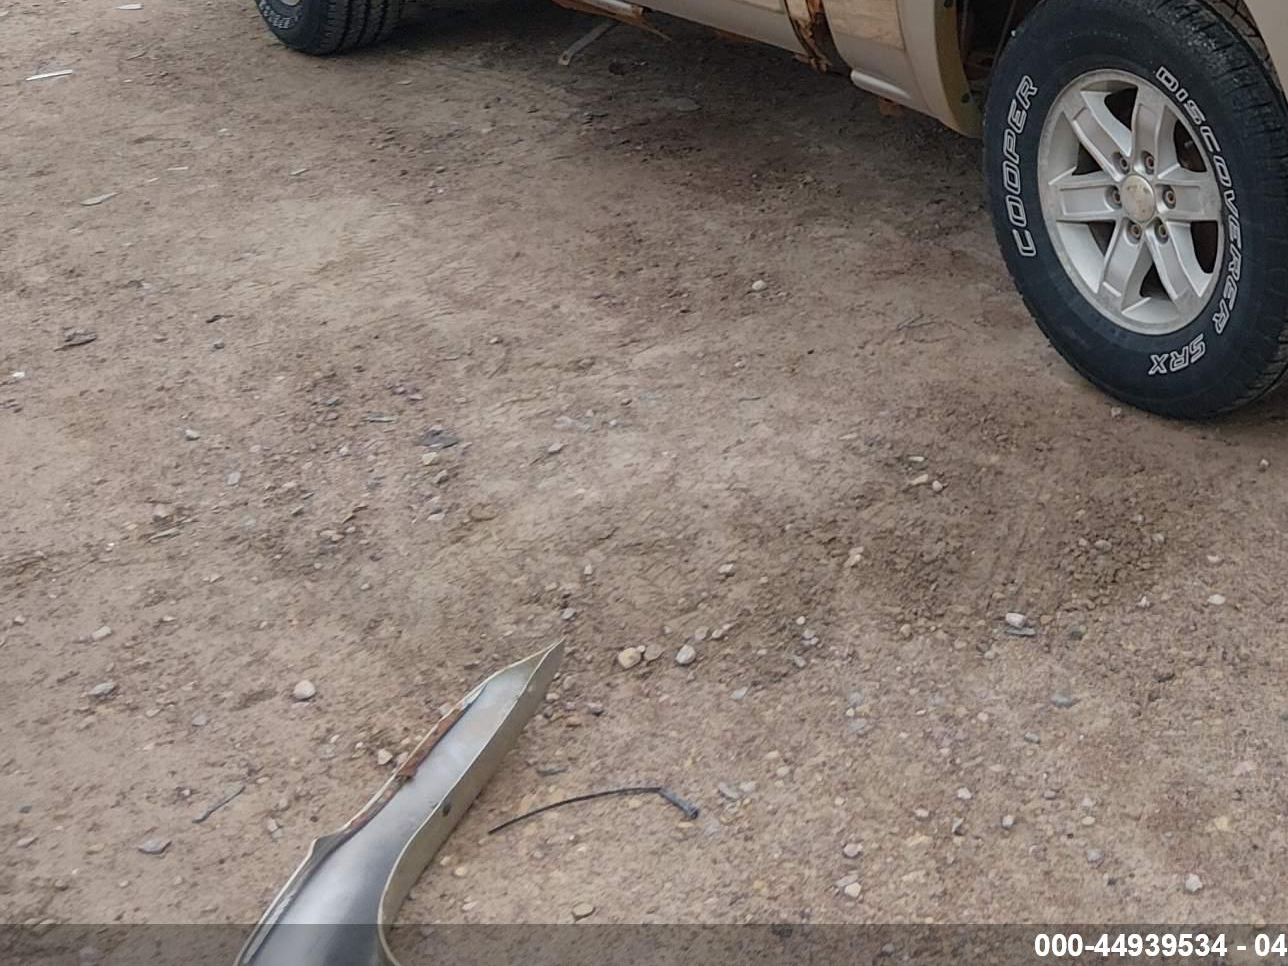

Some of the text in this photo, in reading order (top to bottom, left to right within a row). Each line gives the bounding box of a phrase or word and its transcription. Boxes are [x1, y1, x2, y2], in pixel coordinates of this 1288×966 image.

[1002, 75, 1039, 257] COOPER
[1148, 66, 1242, 376] DISCOVERER SRX
